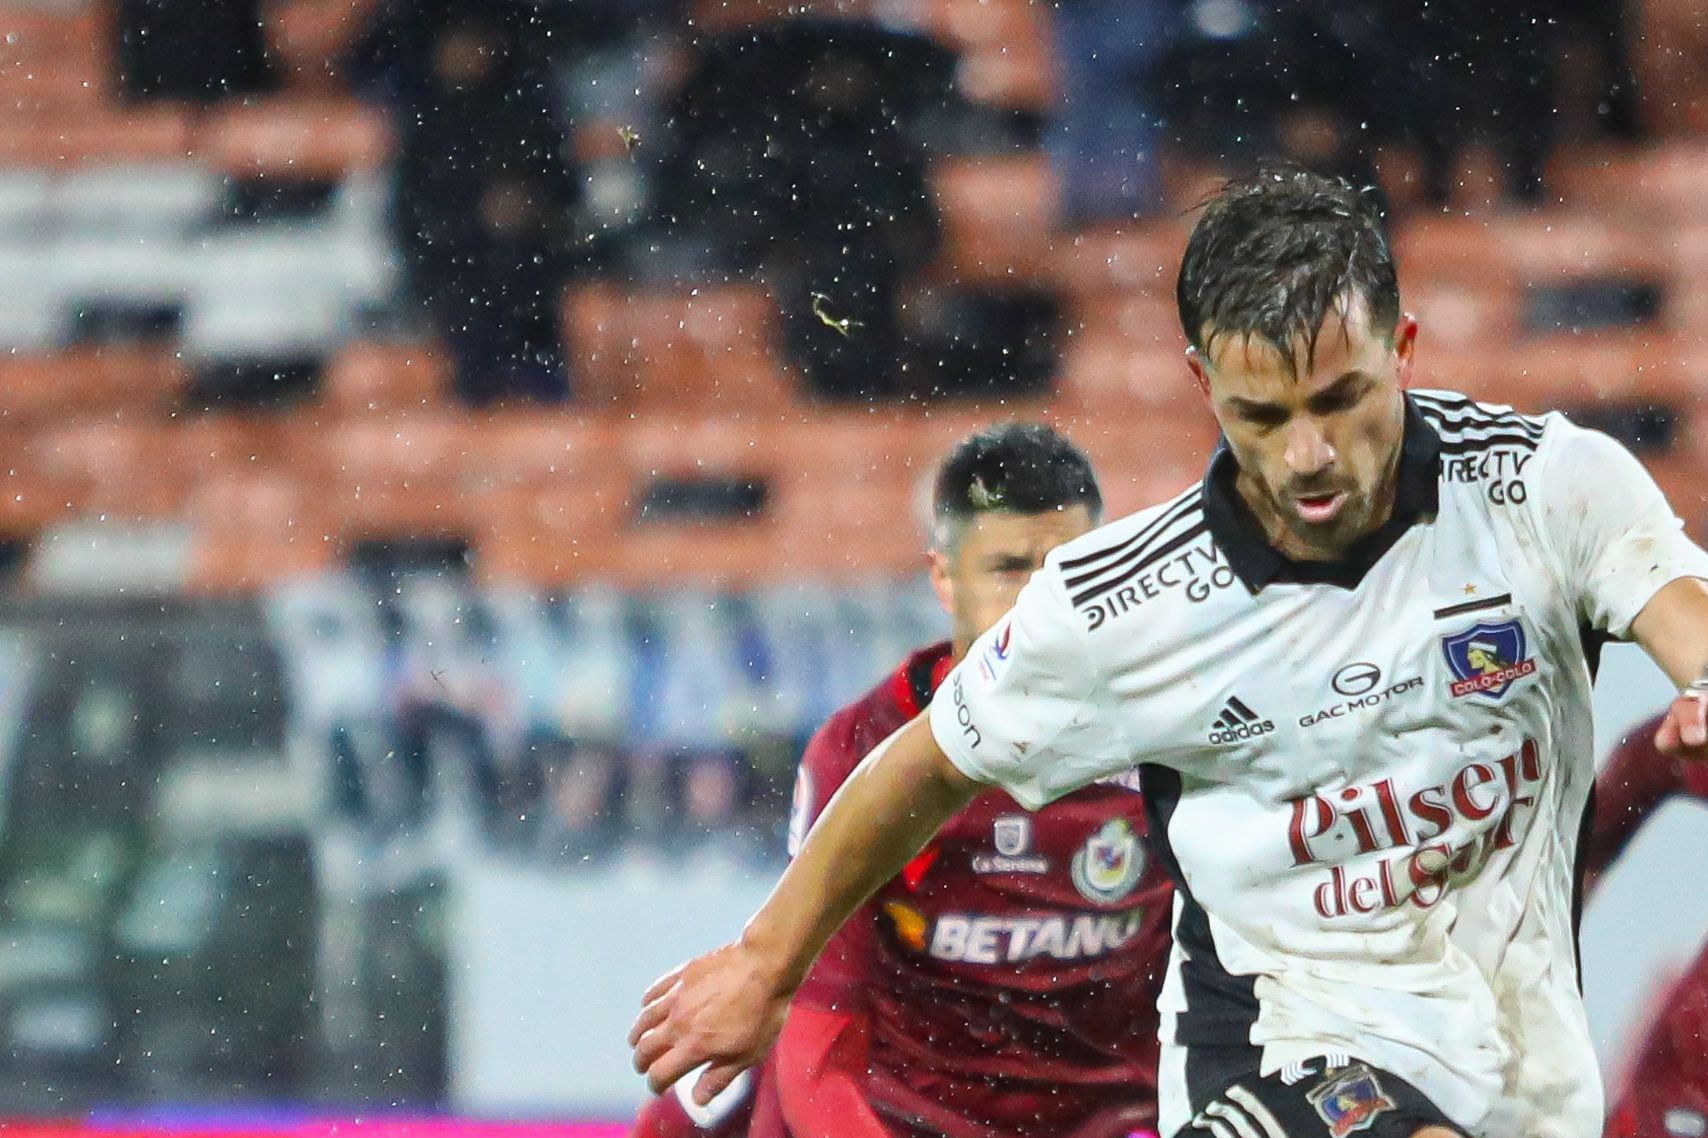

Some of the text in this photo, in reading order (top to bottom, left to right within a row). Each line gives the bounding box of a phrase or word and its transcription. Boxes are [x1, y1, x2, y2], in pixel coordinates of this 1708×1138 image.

[1488, 479, 1527, 505] GO
[1081, 541, 1219, 633] DIRECTV
[1185, 565, 1234, 603] GO
[1453, 661, 1534, 697] COLO-COLO
[1299, 676, 1424, 728] GAC MOTOR
[1208, 718, 1275, 746] adidas
[1288, 735, 1541, 868] Pilsen
[1313, 858, 1399, 919] del
